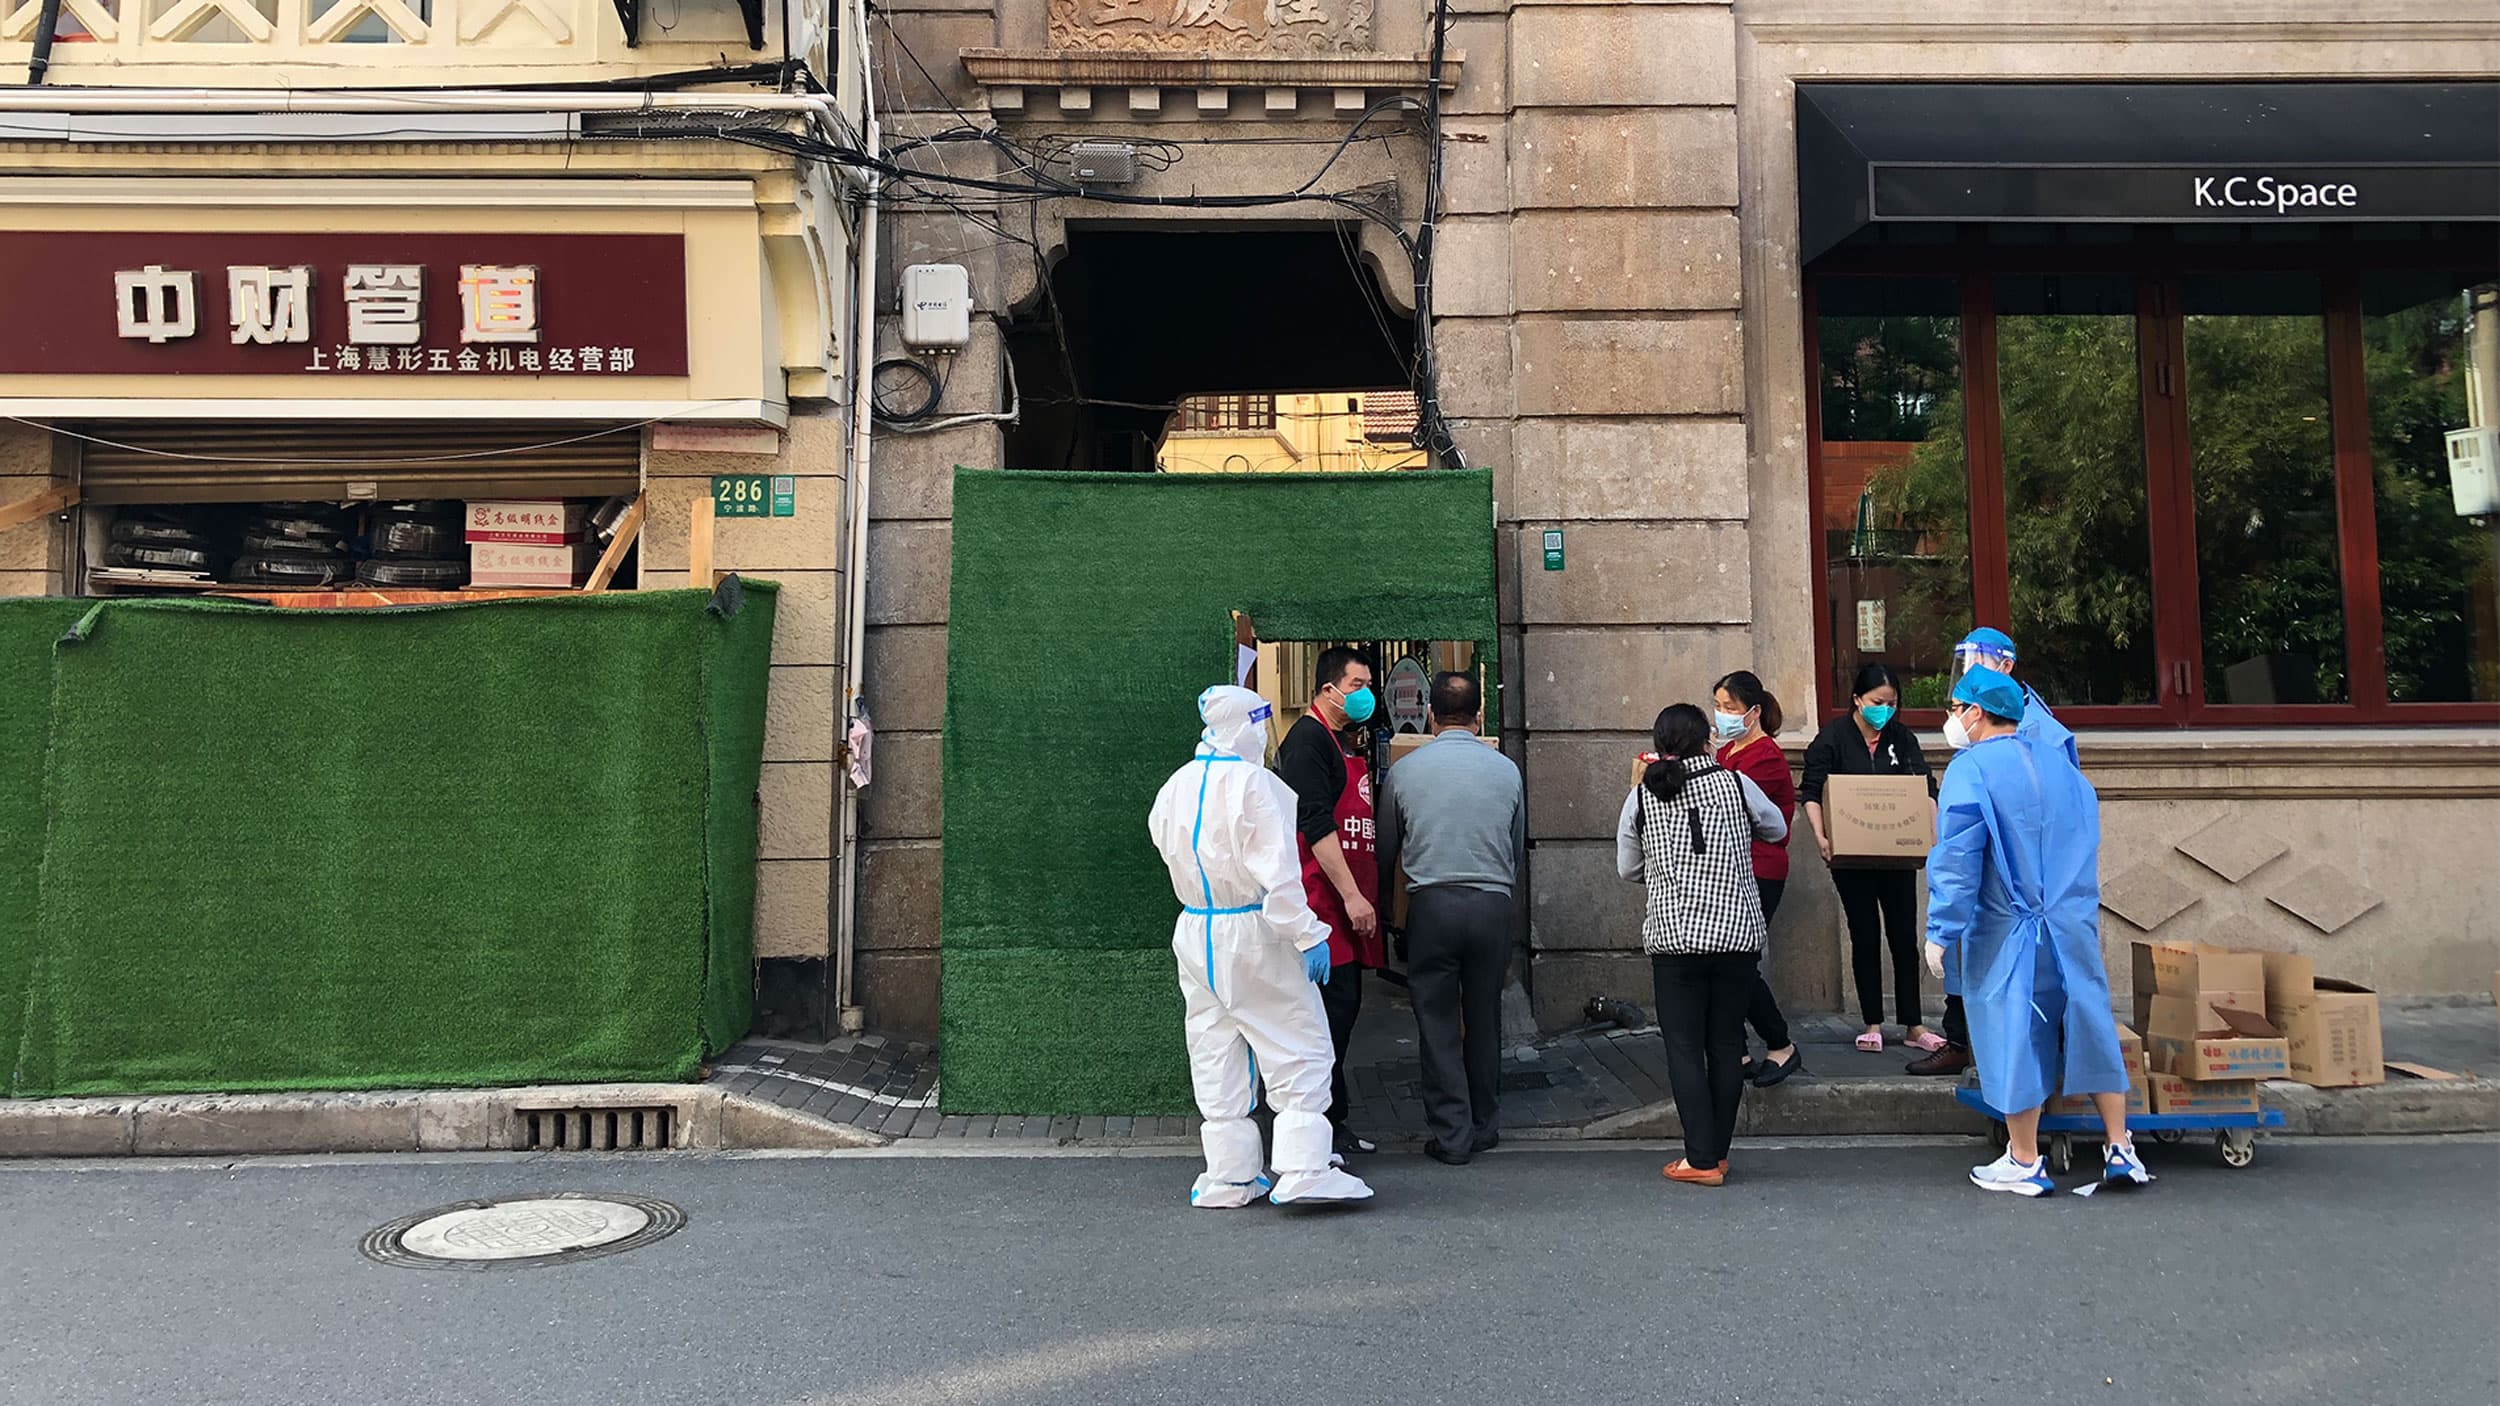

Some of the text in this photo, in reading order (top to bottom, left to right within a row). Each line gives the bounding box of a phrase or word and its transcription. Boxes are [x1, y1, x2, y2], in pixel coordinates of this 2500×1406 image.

[2194, 176, 2358, 214] K.C.Space
[114, 264, 543, 345] 中财管道
[305, 344, 636, 373] 上海慧形五金机电经营部
[719, 479, 763, 502] 286
[1343, 815, 1376, 839] 中国
